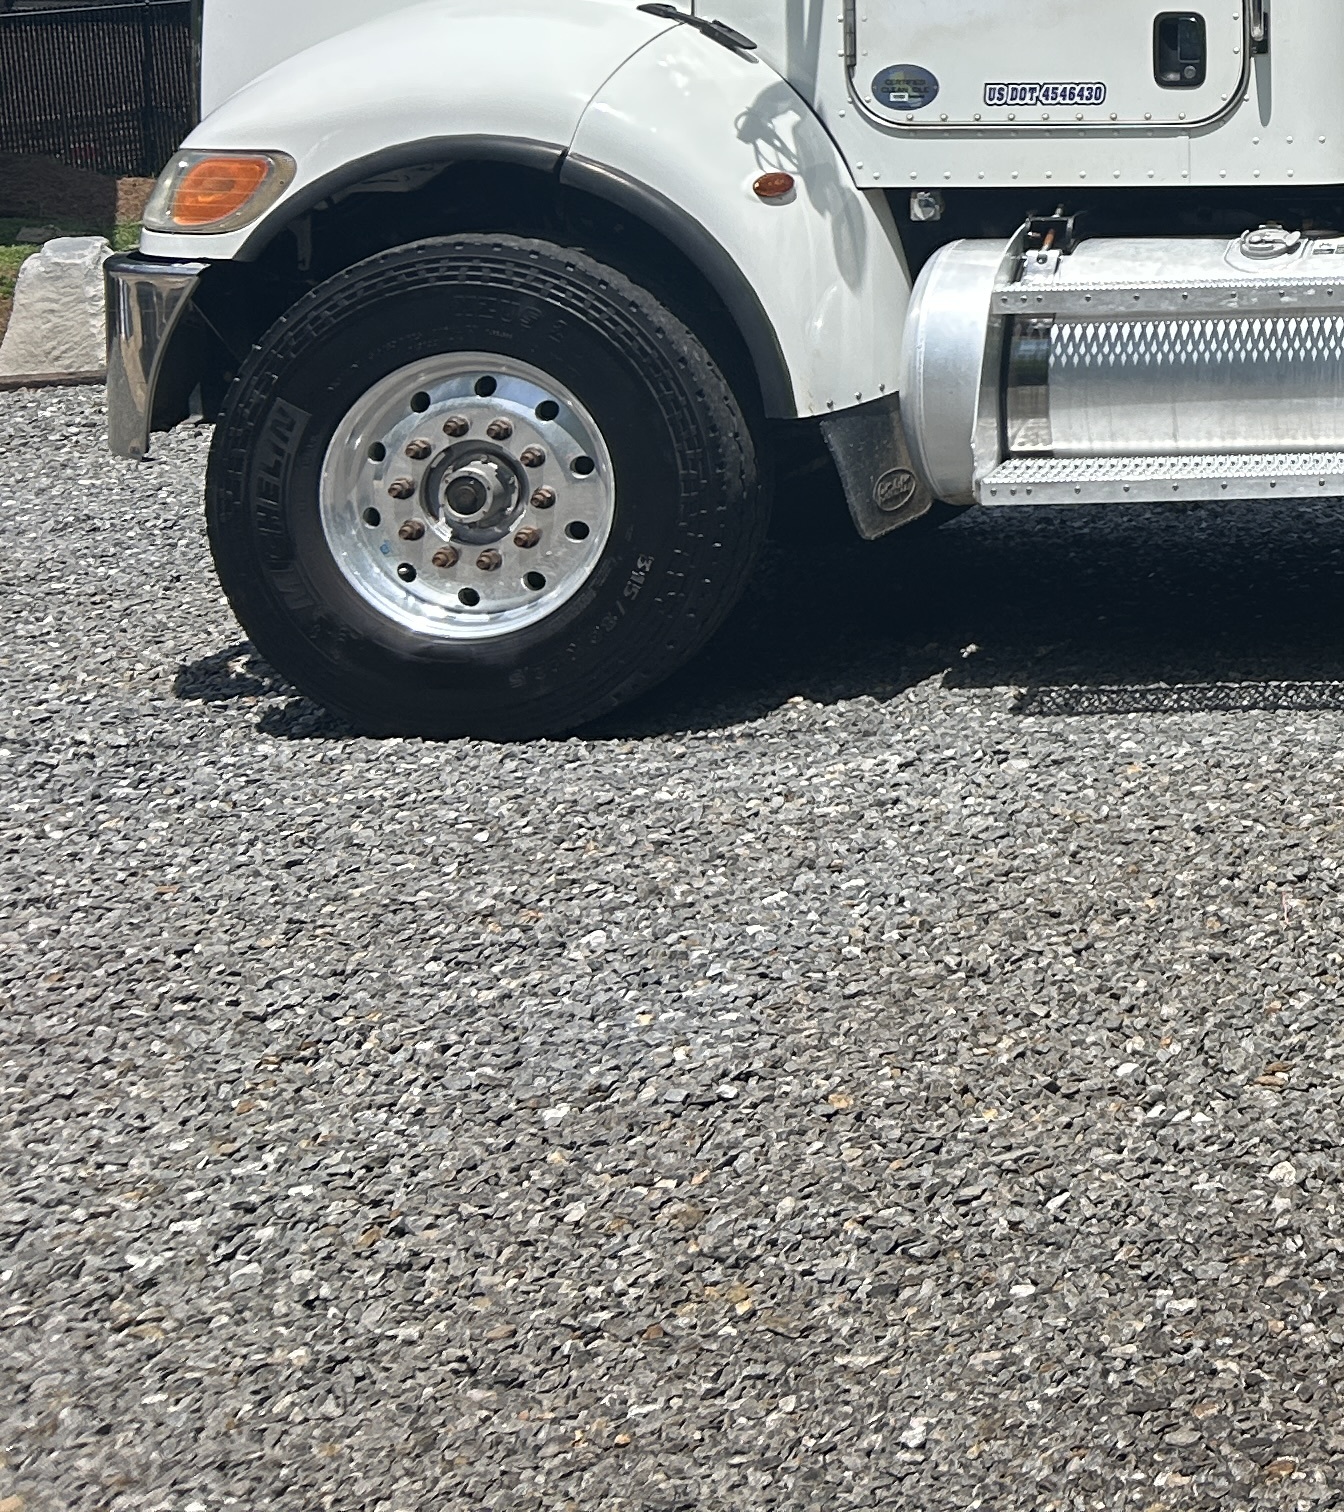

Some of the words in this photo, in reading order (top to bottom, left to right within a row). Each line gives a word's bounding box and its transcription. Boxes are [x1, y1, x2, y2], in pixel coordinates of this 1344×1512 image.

[987, 85, 1005, 102] US
[1009, 86, 1037, 101] DOT
[1041, 85, 1102, 101] 4546430
[255, 401, 313, 614] MICHELIN
